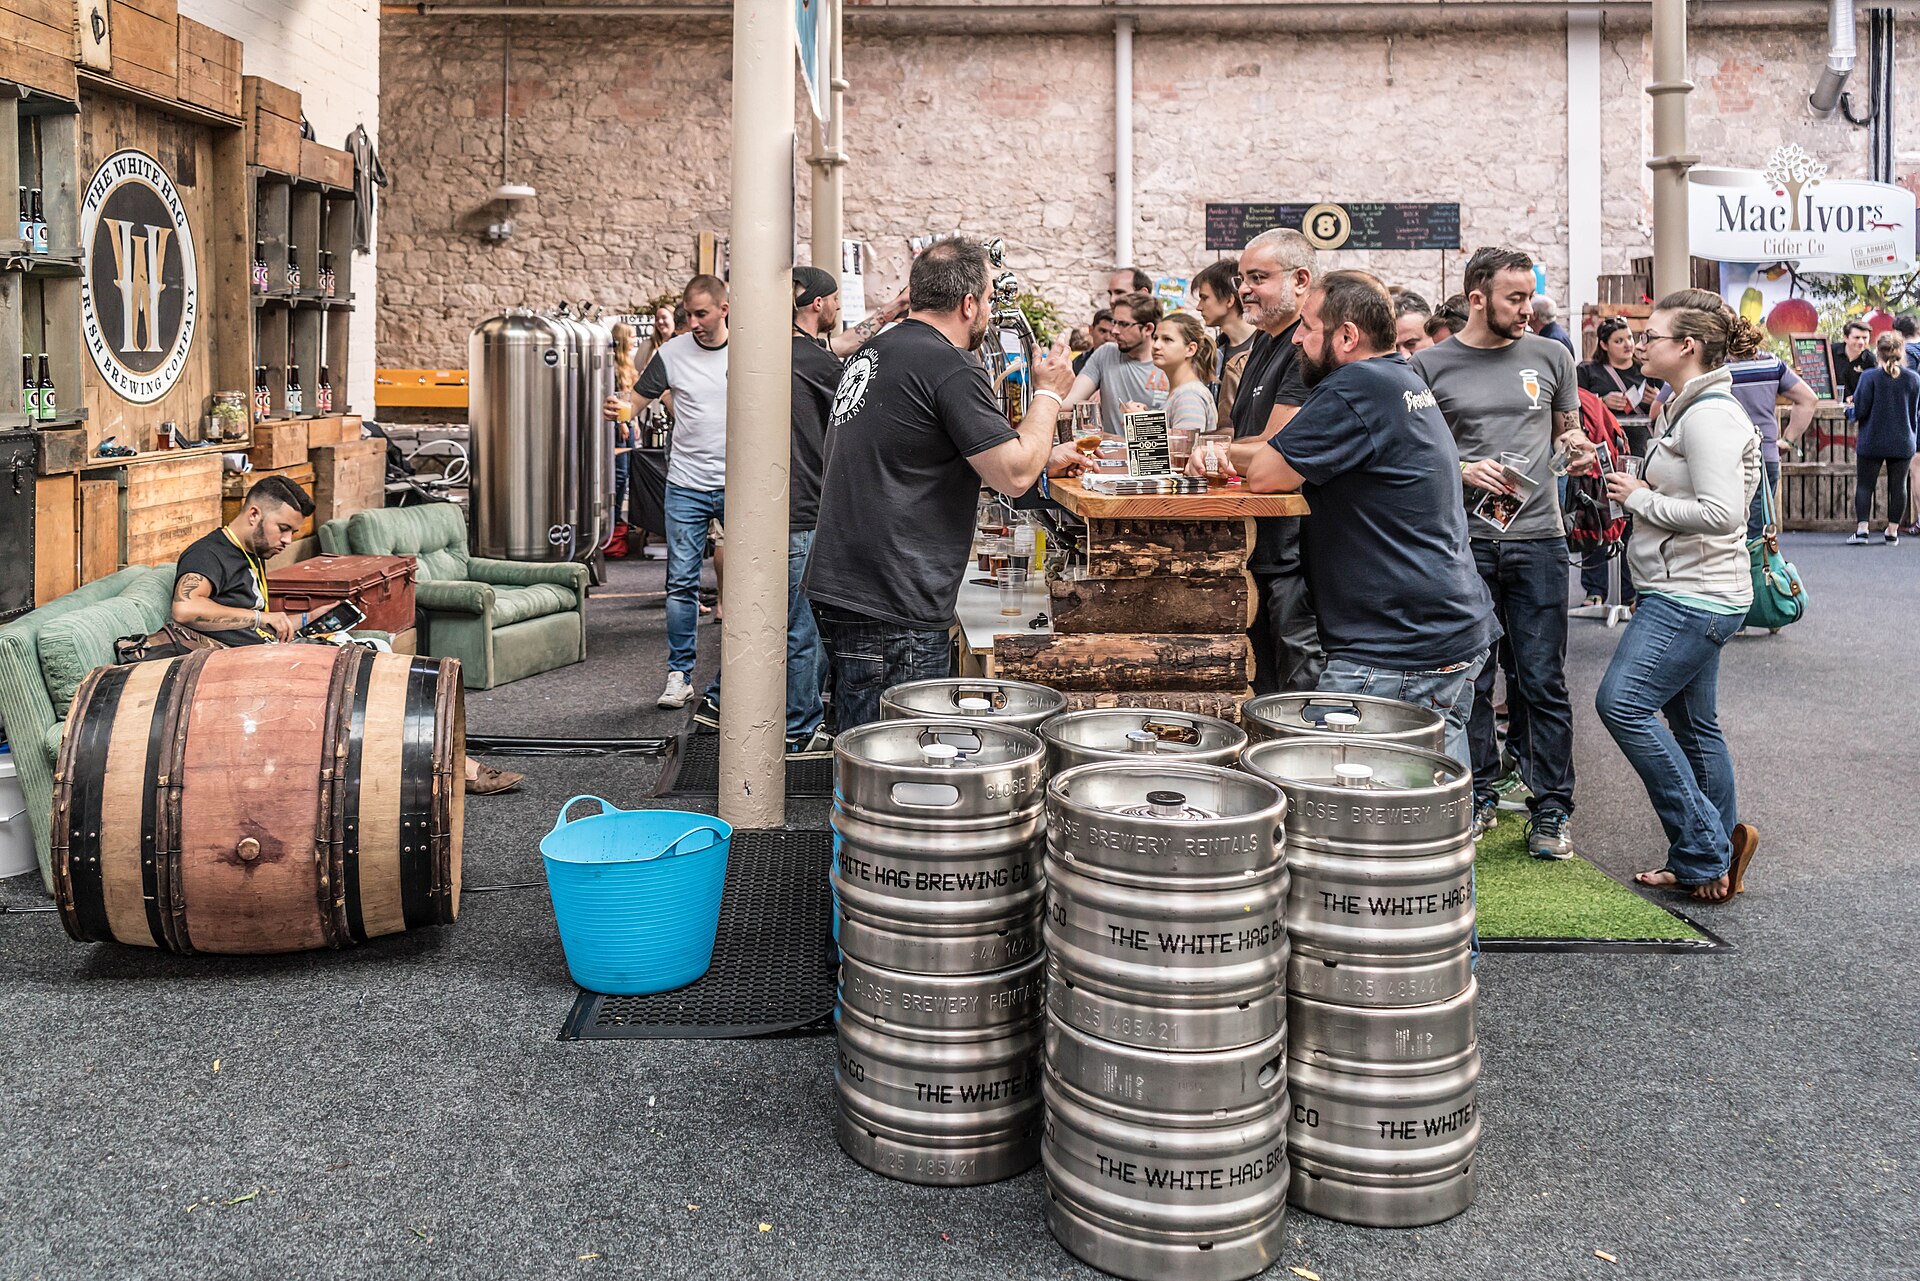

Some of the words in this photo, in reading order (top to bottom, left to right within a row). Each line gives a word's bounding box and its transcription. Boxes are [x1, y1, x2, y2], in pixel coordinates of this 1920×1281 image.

[87, 167, 113, 212] THE
[113, 157, 161, 187] WHITE
[160, 180, 185, 228] HAG
[1716, 195, 1786, 233] Mac
[1803, 194, 1883, 233] Ivors
[1763, 238, 1802, 255] Cider
[1808, 239, 1825, 255] Co
[81, 284, 105, 352] IRISH
[103, 356, 162, 396] BREWING
[165, 287, 195, 381] COMPANY
[986, 777, 1026, 800] CLOSE
[1352, 805, 1431, 825] BREWERY
[1089, 826, 1172, 858] BREWERY
[1184, 833, 1259, 858] RENTALS
[875, 866, 910, 889] HAG
[915, 869, 1009, 891] BREWING
[1011, 861, 1029, 884] CO
[1053, 902, 1067, 927] CO
[1319, 890, 1361, 915] THE
[1368, 894, 1438, 916] WHITE
[1442, 885, 1466, 911] HAG
[1108, 924, 1150, 952] THE
[1158, 932, 1234, 955] WHITE
[1238, 924, 1269, 951] HAG
[854, 977, 893, 1006] CLOSE
[902, 992, 980, 1014] BREWERY
[1110, 1014, 1180, 1042] 485421
[849, 1058, 865, 1082] CO
[914, 1082, 954, 1104] THE
[959, 1075, 1021, 1104] WHITE
[1294, 1103, 1319, 1128] CO
[1377, 1120, 1418, 1140] THE
[1423, 1102, 1471, 1138] WHITE
[914, 1158, 977, 1178] 485421
[1097, 1153, 1137, 1185] THE
[1144, 1167, 1224, 1191] WHITE
[1229, 1159, 1263, 1187] HAG
